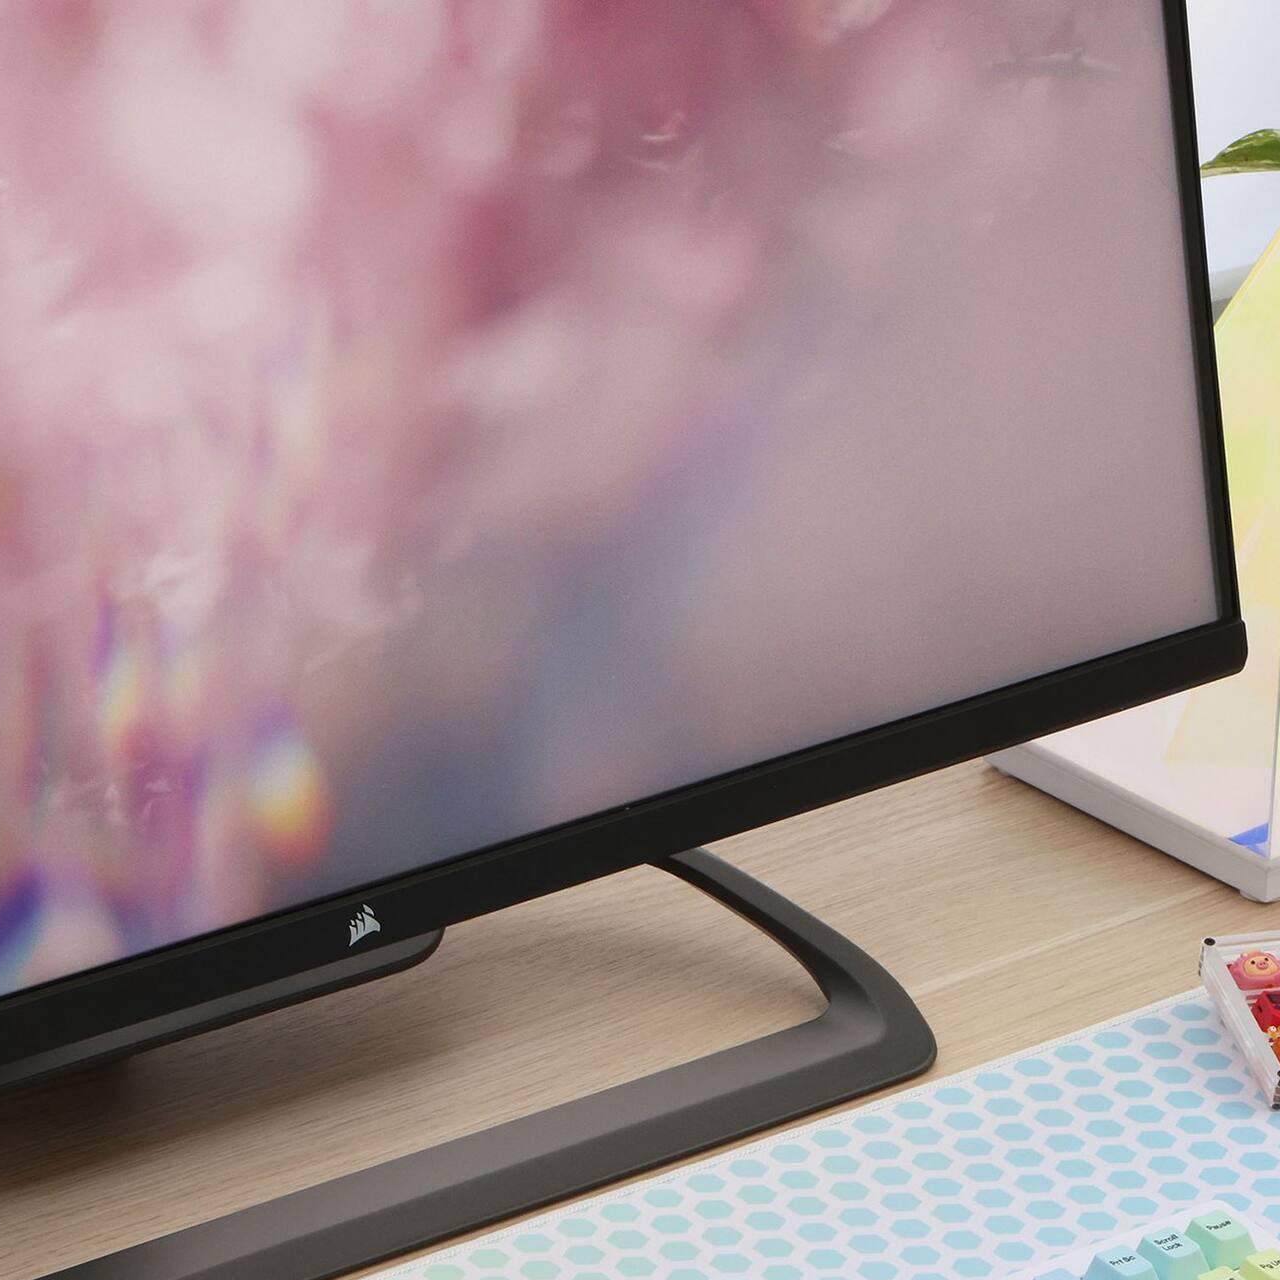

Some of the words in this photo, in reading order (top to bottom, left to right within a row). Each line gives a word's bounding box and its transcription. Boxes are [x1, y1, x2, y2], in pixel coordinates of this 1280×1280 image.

[1206, 1220, 1232, 1231] Pause
[1154, 1233, 1178, 1245] Scroll
[1162, 1242, 1182, 1251] Lock
